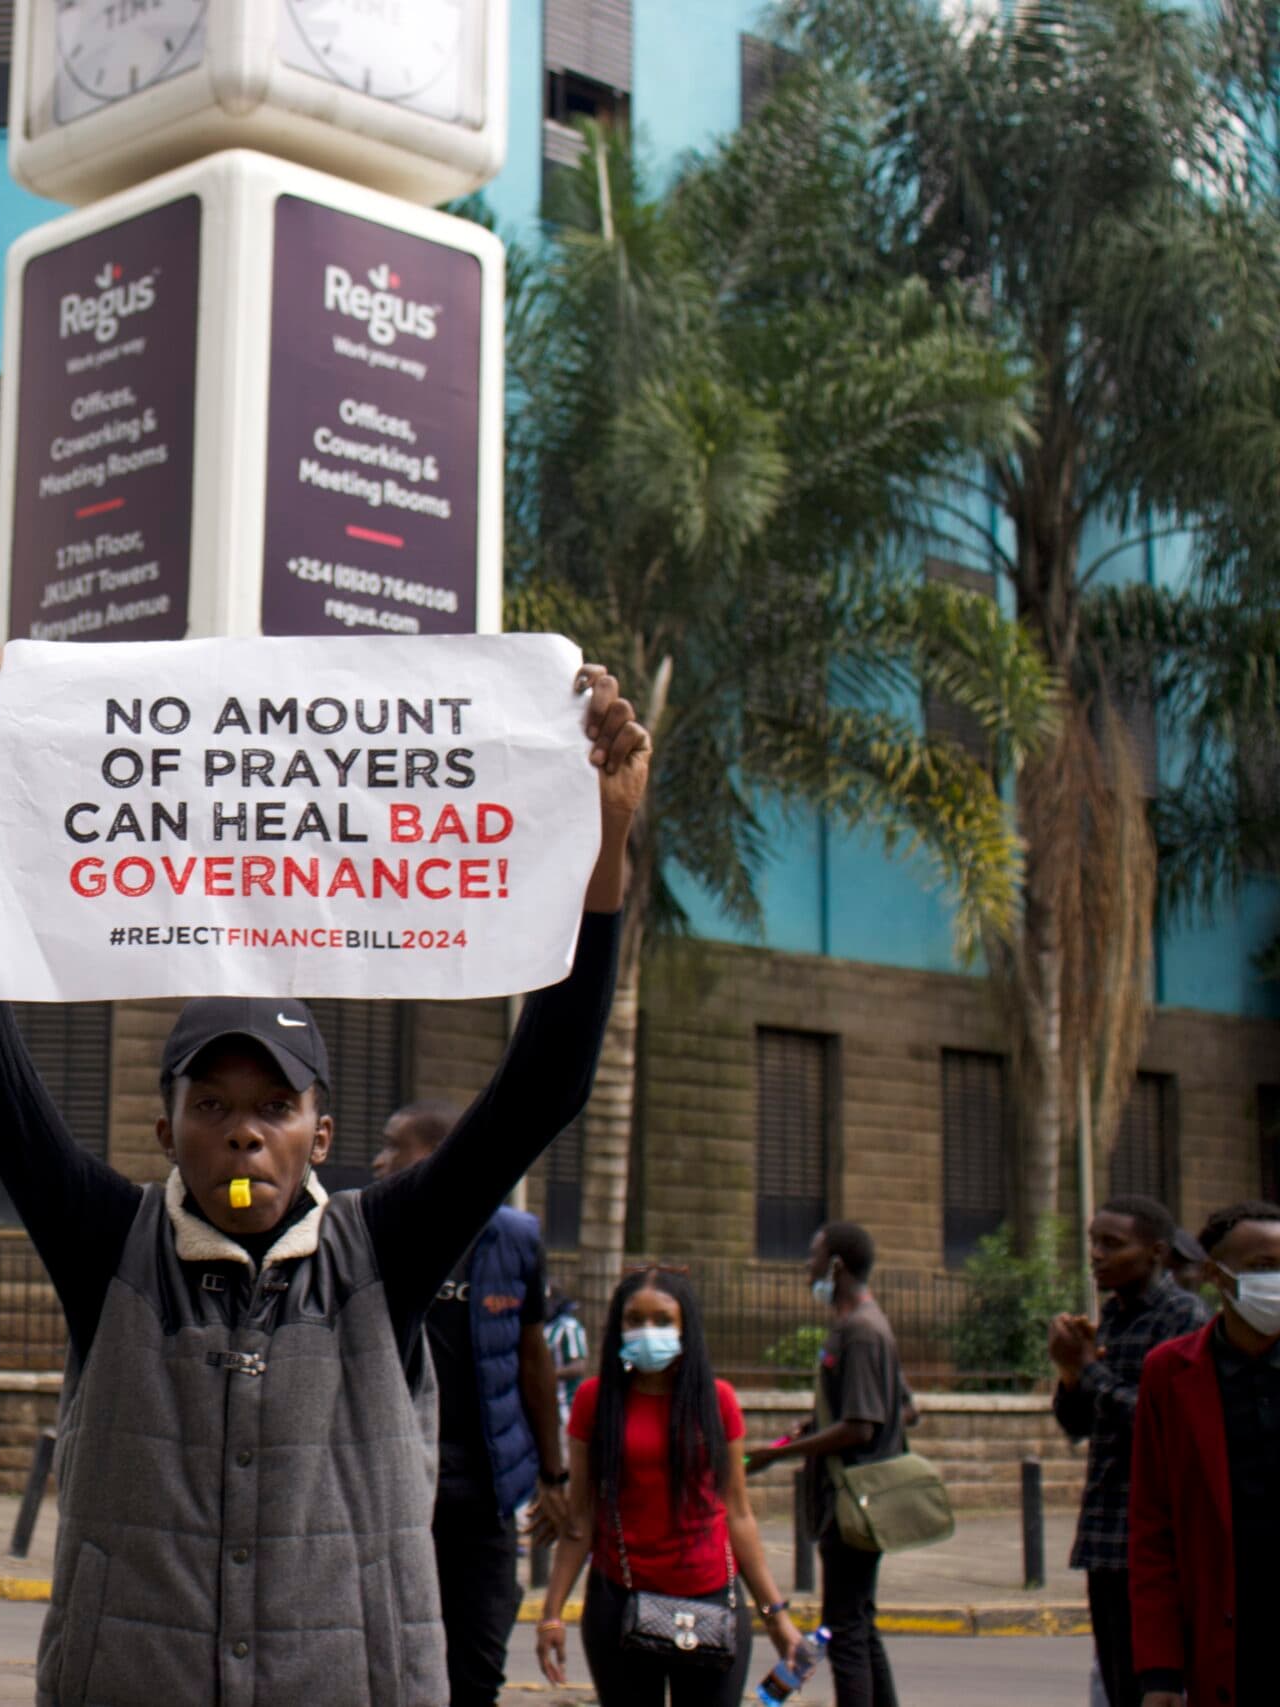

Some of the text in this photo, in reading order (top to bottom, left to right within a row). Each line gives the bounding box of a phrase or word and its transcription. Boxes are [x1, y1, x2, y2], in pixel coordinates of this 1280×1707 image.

[59, 275, 156, 342] Regus
[325, 264, 437, 346] Regus
[368, 348, 399, 368] your
[400, 359, 427, 381] way
[51, 408, 157, 461] Coworking &
[339, 398, 417, 444] Offices,
[39, 445, 168, 497] Meeting Rooms
[314, 427, 439, 482] Coworking &
[299, 458, 451, 519] Meeting Rooms
[56, 538, 93, 570] 17th
[287, 557, 333, 583] +254
[40, 561, 160, 608] JKUAT Towers
[105, 595, 169, 625] Avenue
[325, 600, 420, 634] regus.com
[107, 697, 470, 734] NO AMOUNT
[102, 748, 475, 788] OF PRAYERS
[65, 802, 513, 843] CAN HEAL BAD
[70, 856, 508, 899] GOVERNANCE!
[110, 927, 466, 949] #REJECTFINANCEBILL2024
